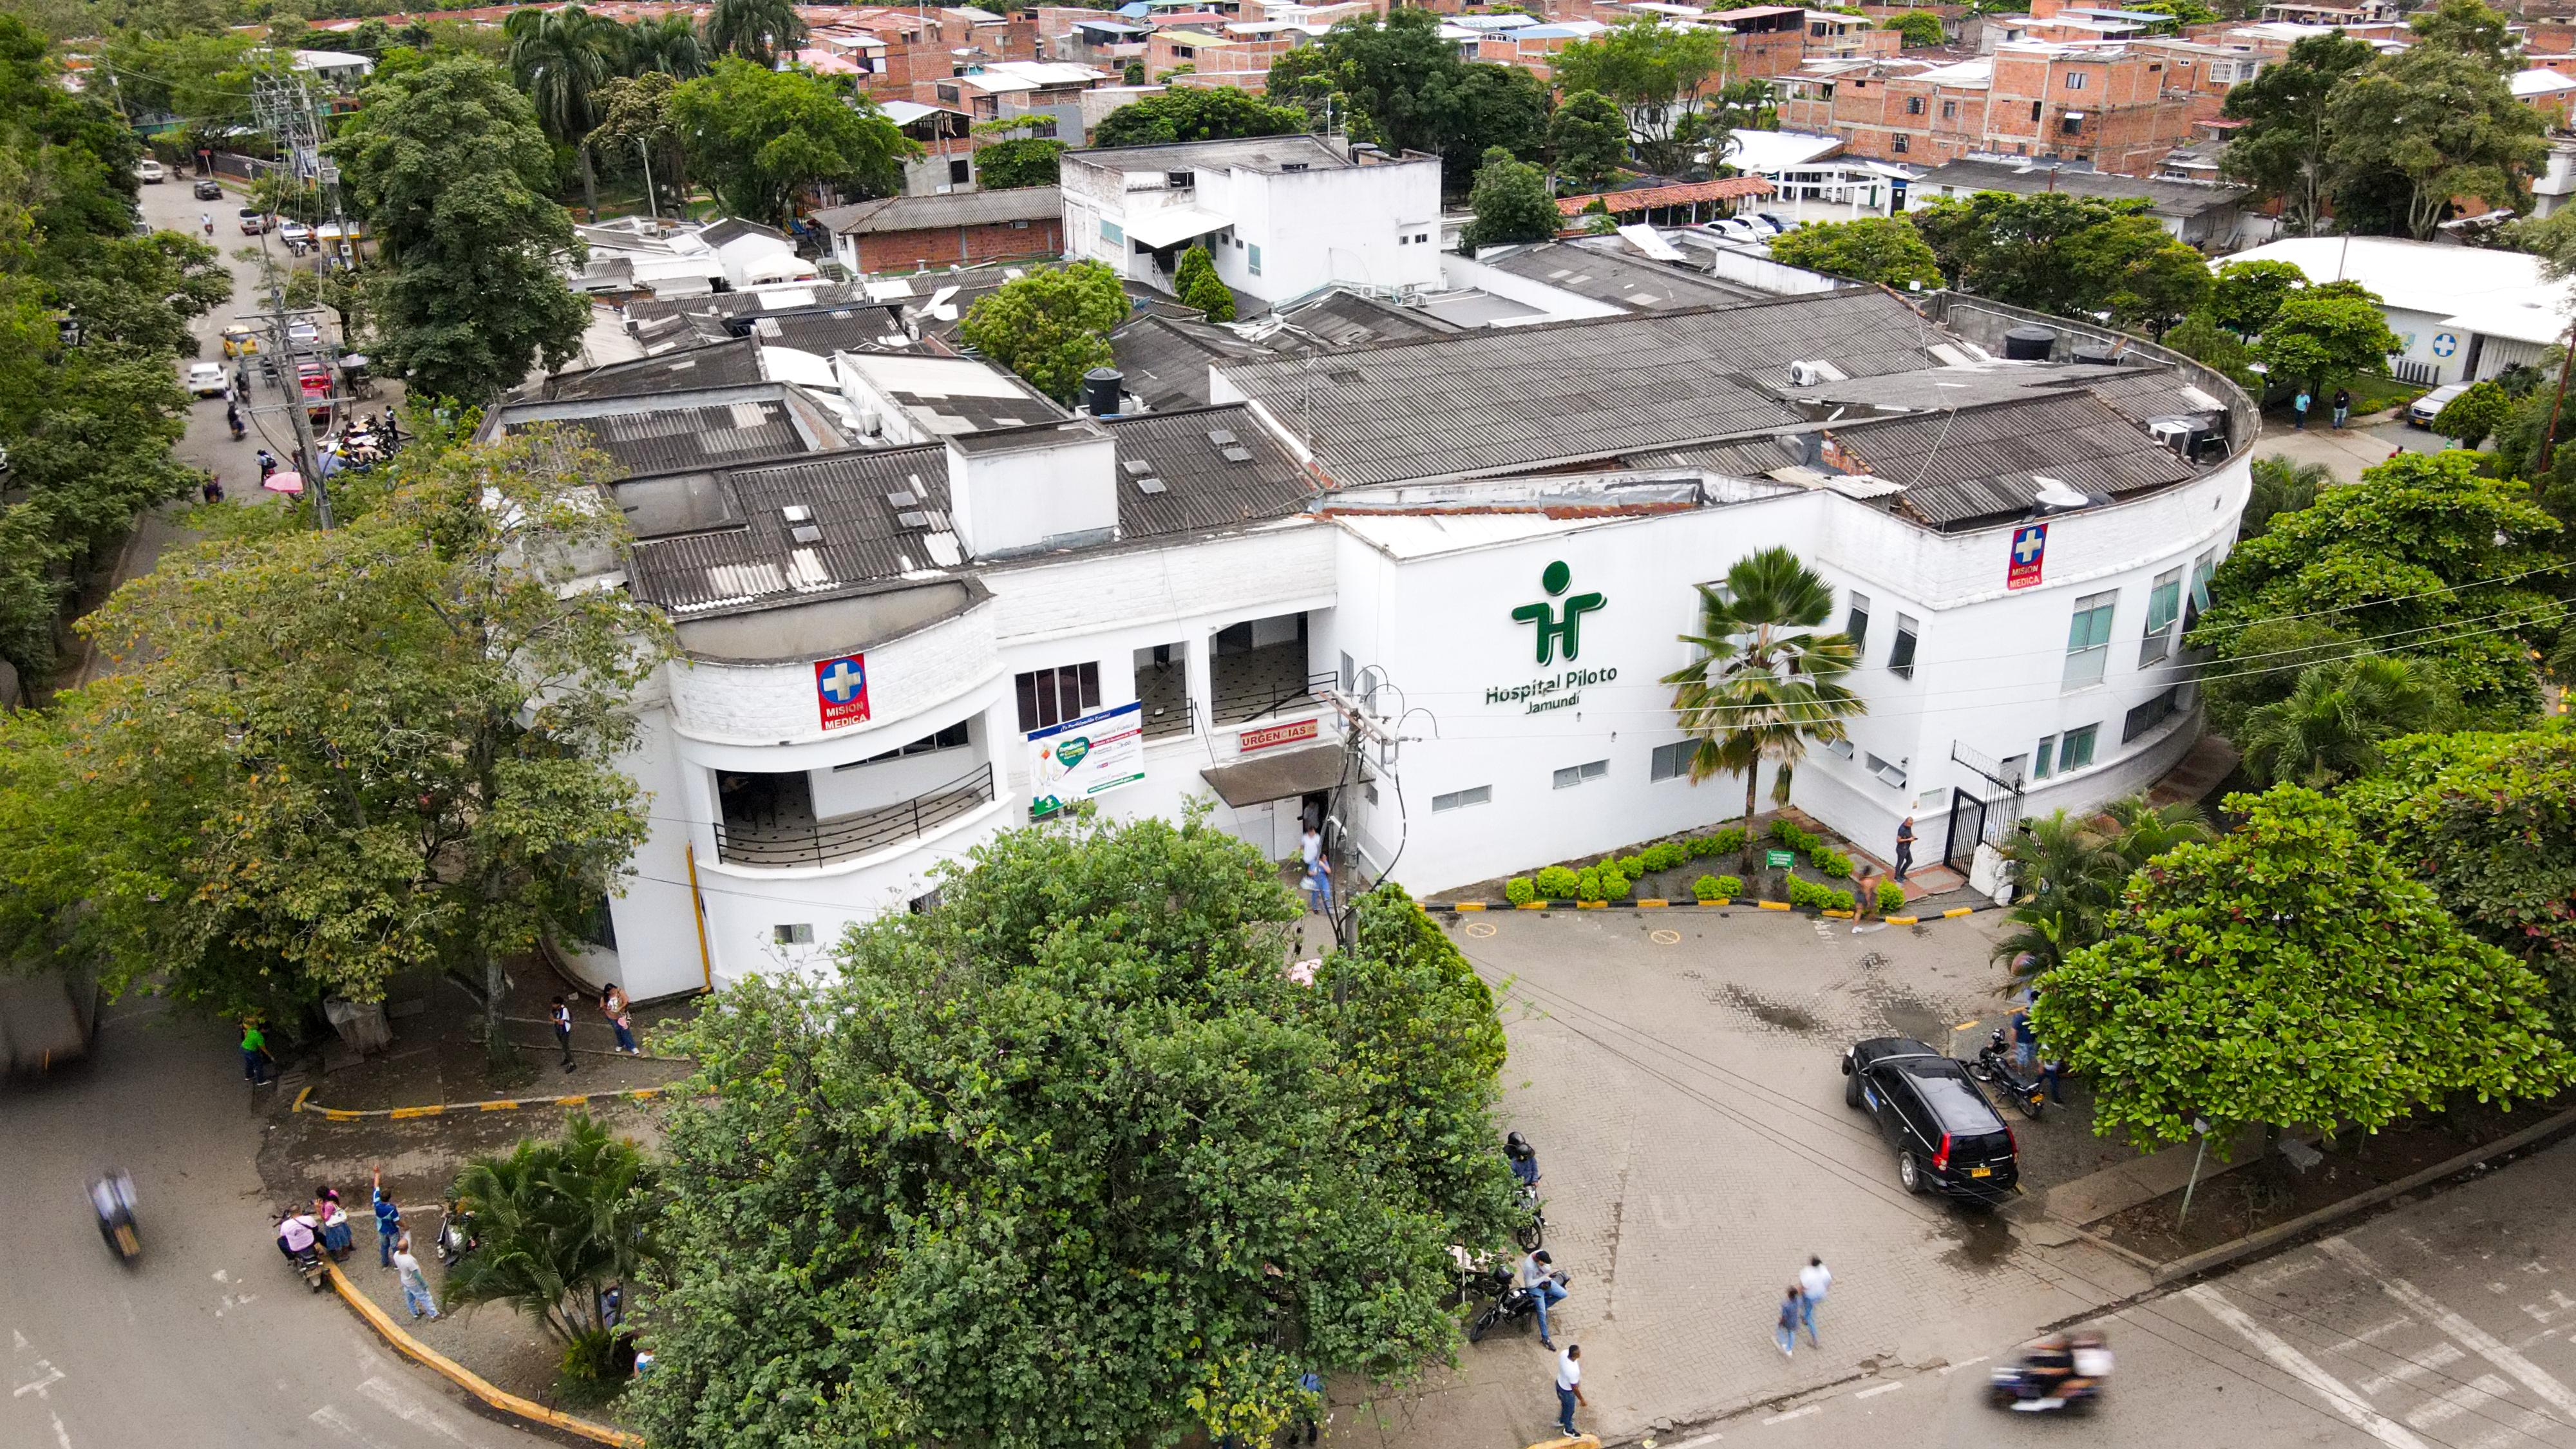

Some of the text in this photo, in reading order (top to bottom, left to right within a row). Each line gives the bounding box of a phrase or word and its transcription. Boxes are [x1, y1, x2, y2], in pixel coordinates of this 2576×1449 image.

[2011, 564, 2038, 576] MISION
[2009, 575, 2040, 588] MEDICA
[1485, 667, 1618, 705] Hospital Piloto
[826, 701, 864, 717] MISION
[1525, 690, 1581, 715] Jamundí
[825, 714, 867, 730] MEDICA
[1242, 726, 1306, 746] URGENCIAS
